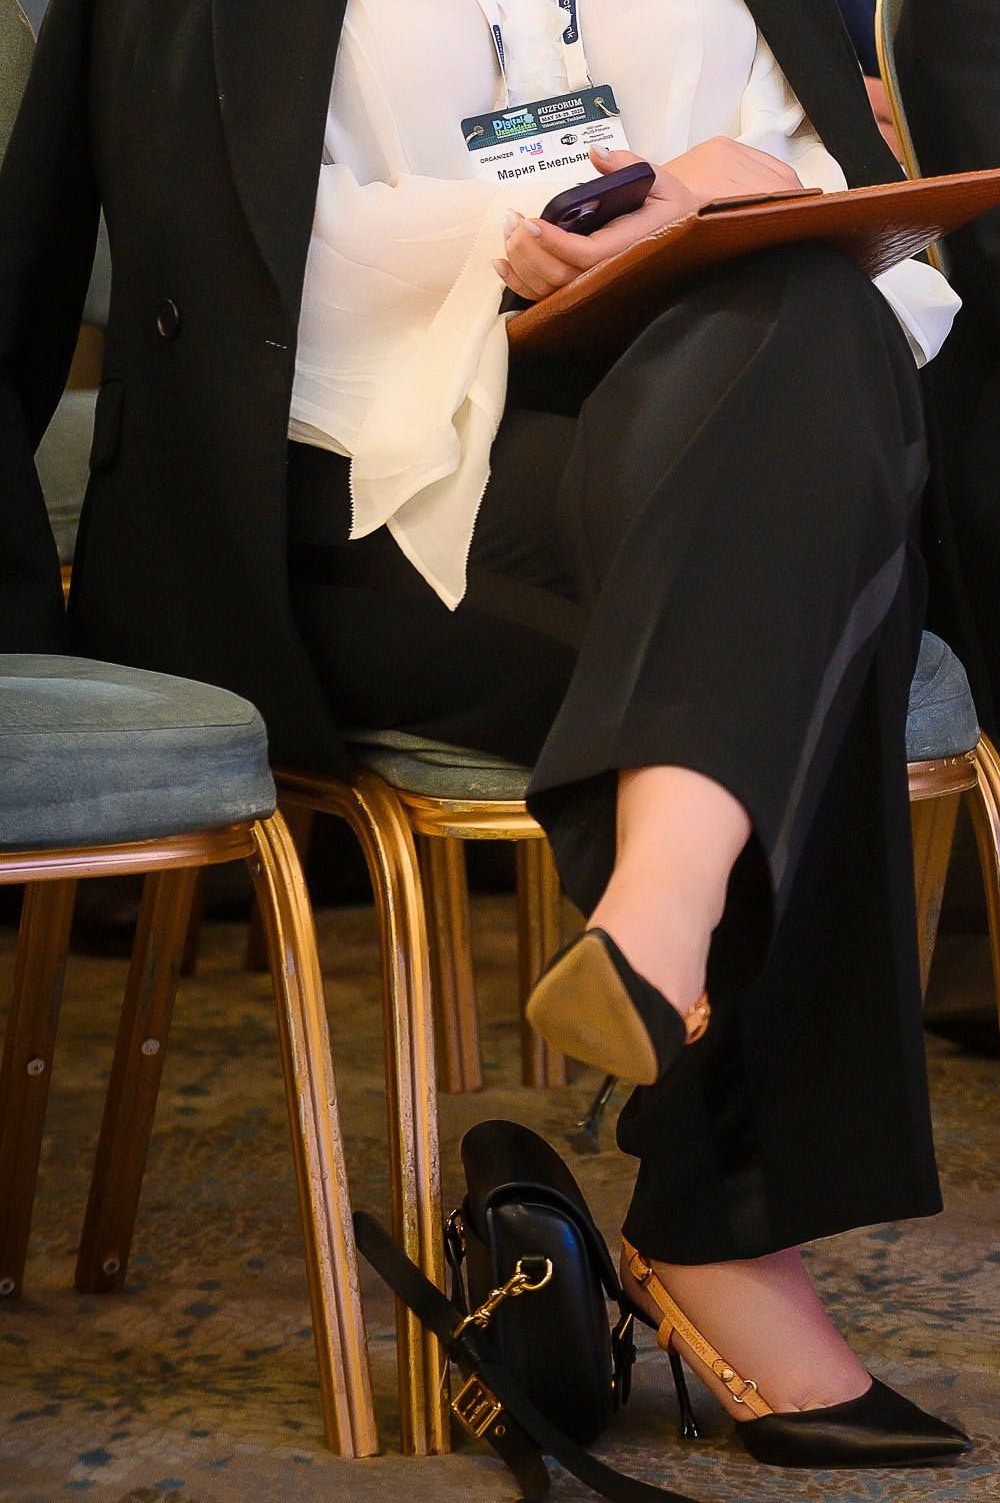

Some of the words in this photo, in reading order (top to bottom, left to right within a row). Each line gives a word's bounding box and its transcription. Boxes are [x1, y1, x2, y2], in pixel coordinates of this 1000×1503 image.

[537, 98, 583, 115] #UZFORUM
[492, 116, 524, 131] Digital
[541, 115, 555, 123] MAY
[519, 142, 543, 154] PLUS
[480, 151, 515, 164] ORGANIZER
[497, 164, 536, 180] Мария
